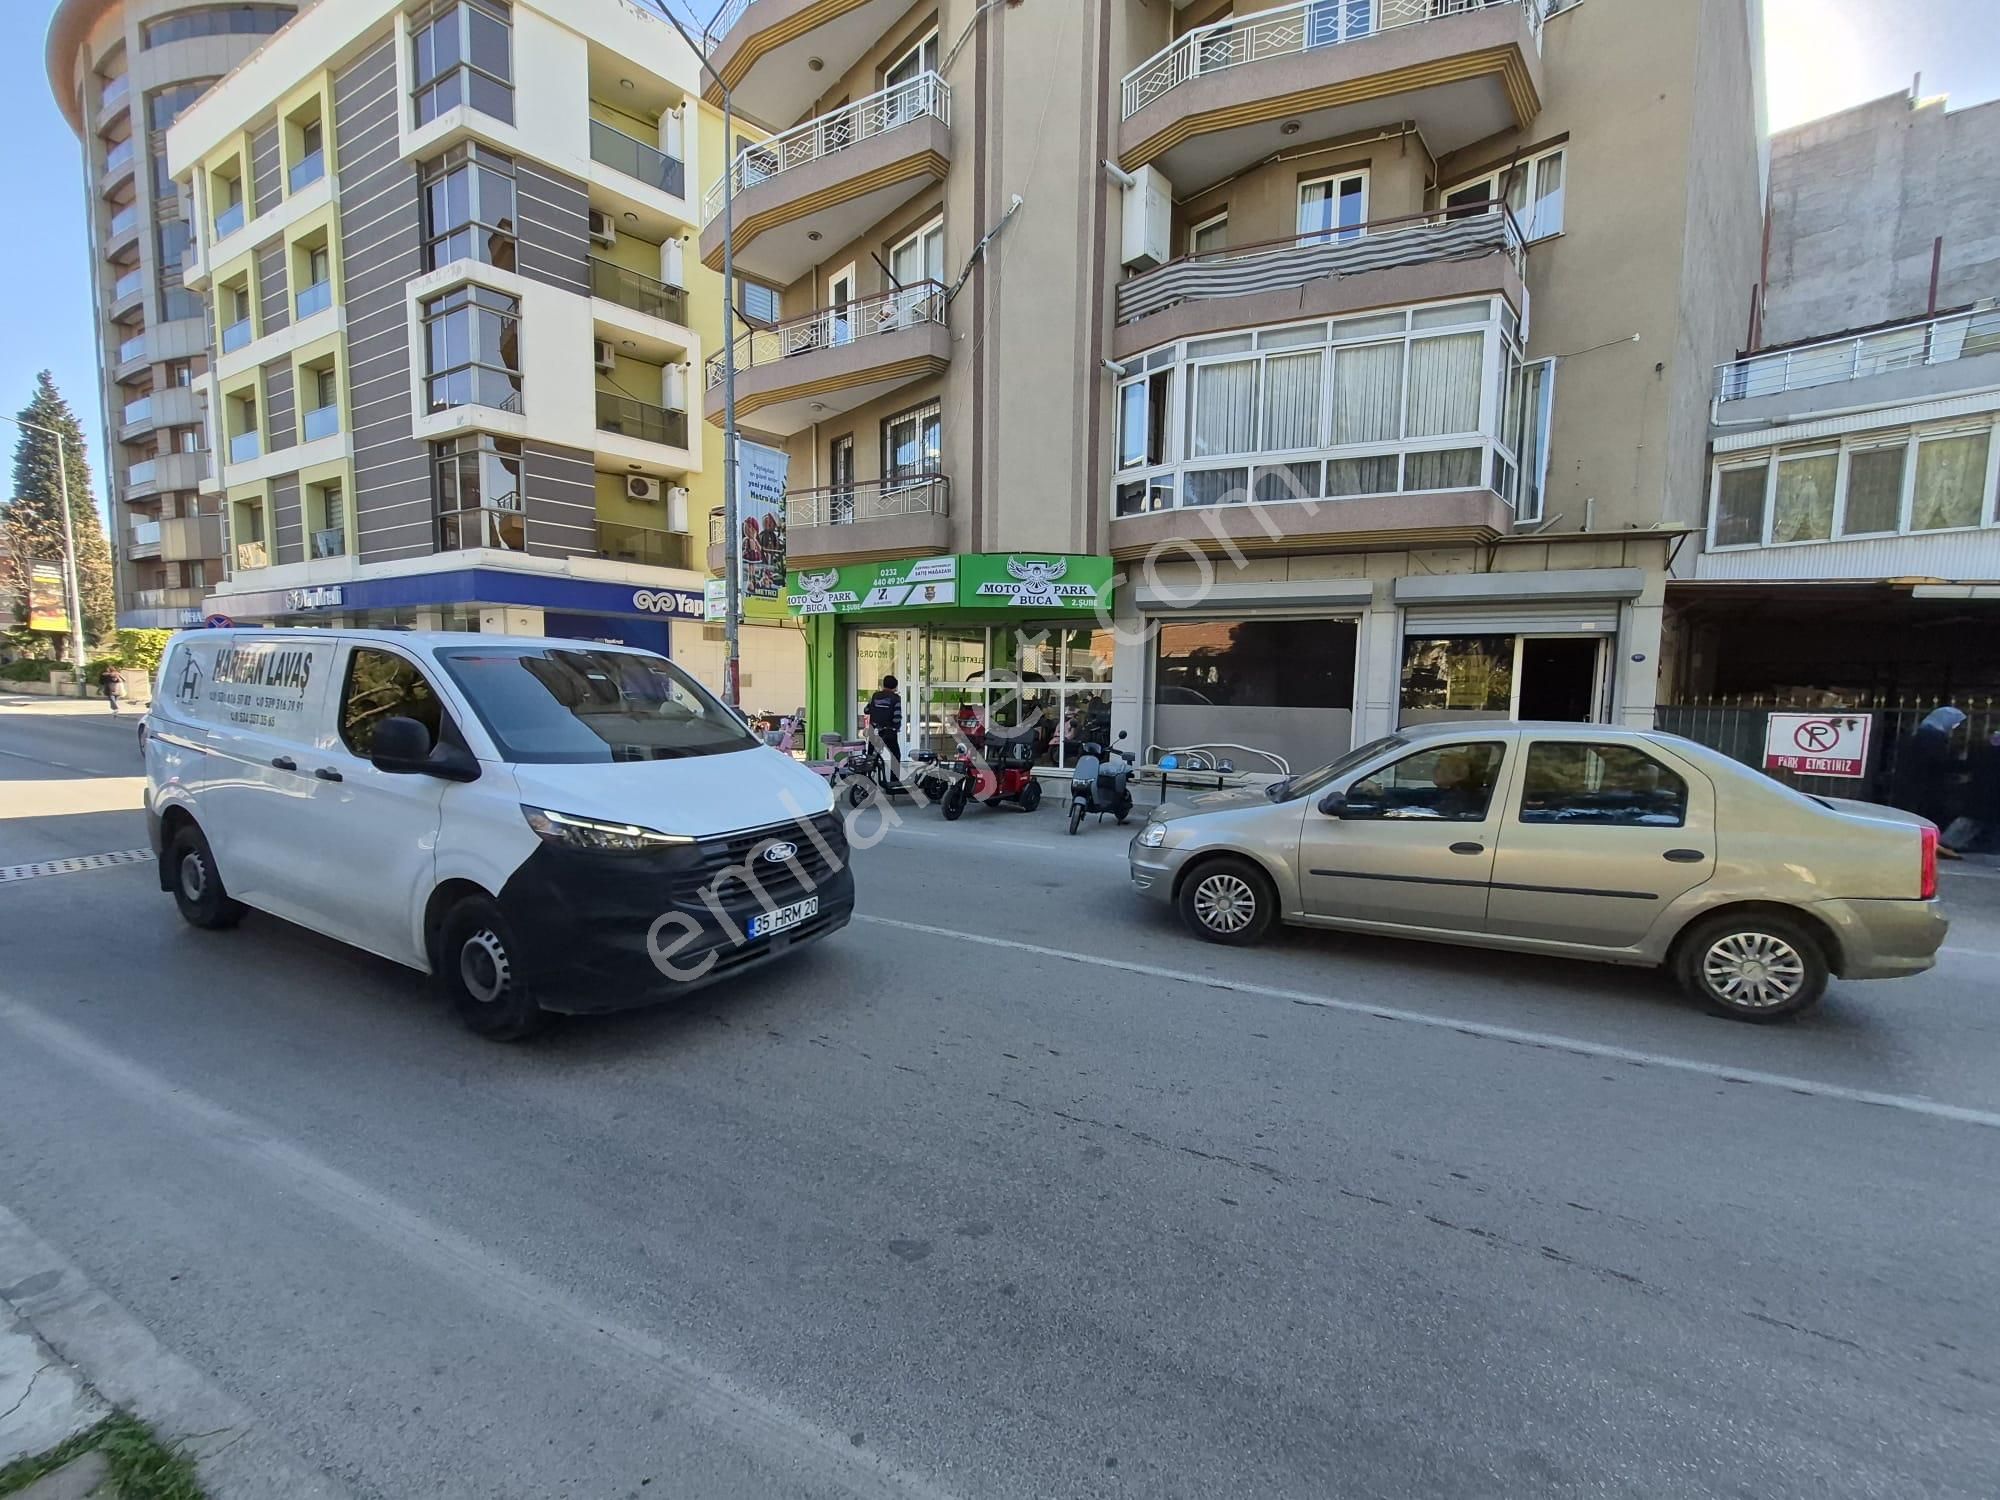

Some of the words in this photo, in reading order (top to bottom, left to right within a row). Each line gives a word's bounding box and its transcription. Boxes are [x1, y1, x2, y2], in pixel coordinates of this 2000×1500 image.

[880, 568, 897, 577] 0232
[873, 578, 887, 587] 440
[895, 576, 905, 585] 20
[984, 584, 1020, 593] MOTO
[1054, 585, 1087, 594] PARK
[828, 591, 851, 602] PARK
[1020, 596, 1053, 605] BUCA
[806, 603, 828, 613] BUCA
[265, 652, 313, 698] LAVAŞ
[1777, 756, 1799, 769] PARK
[754, 914, 770, 934] 35
[774, 903, 802, 928] HRM
[804, 898, 818, 916] 20
